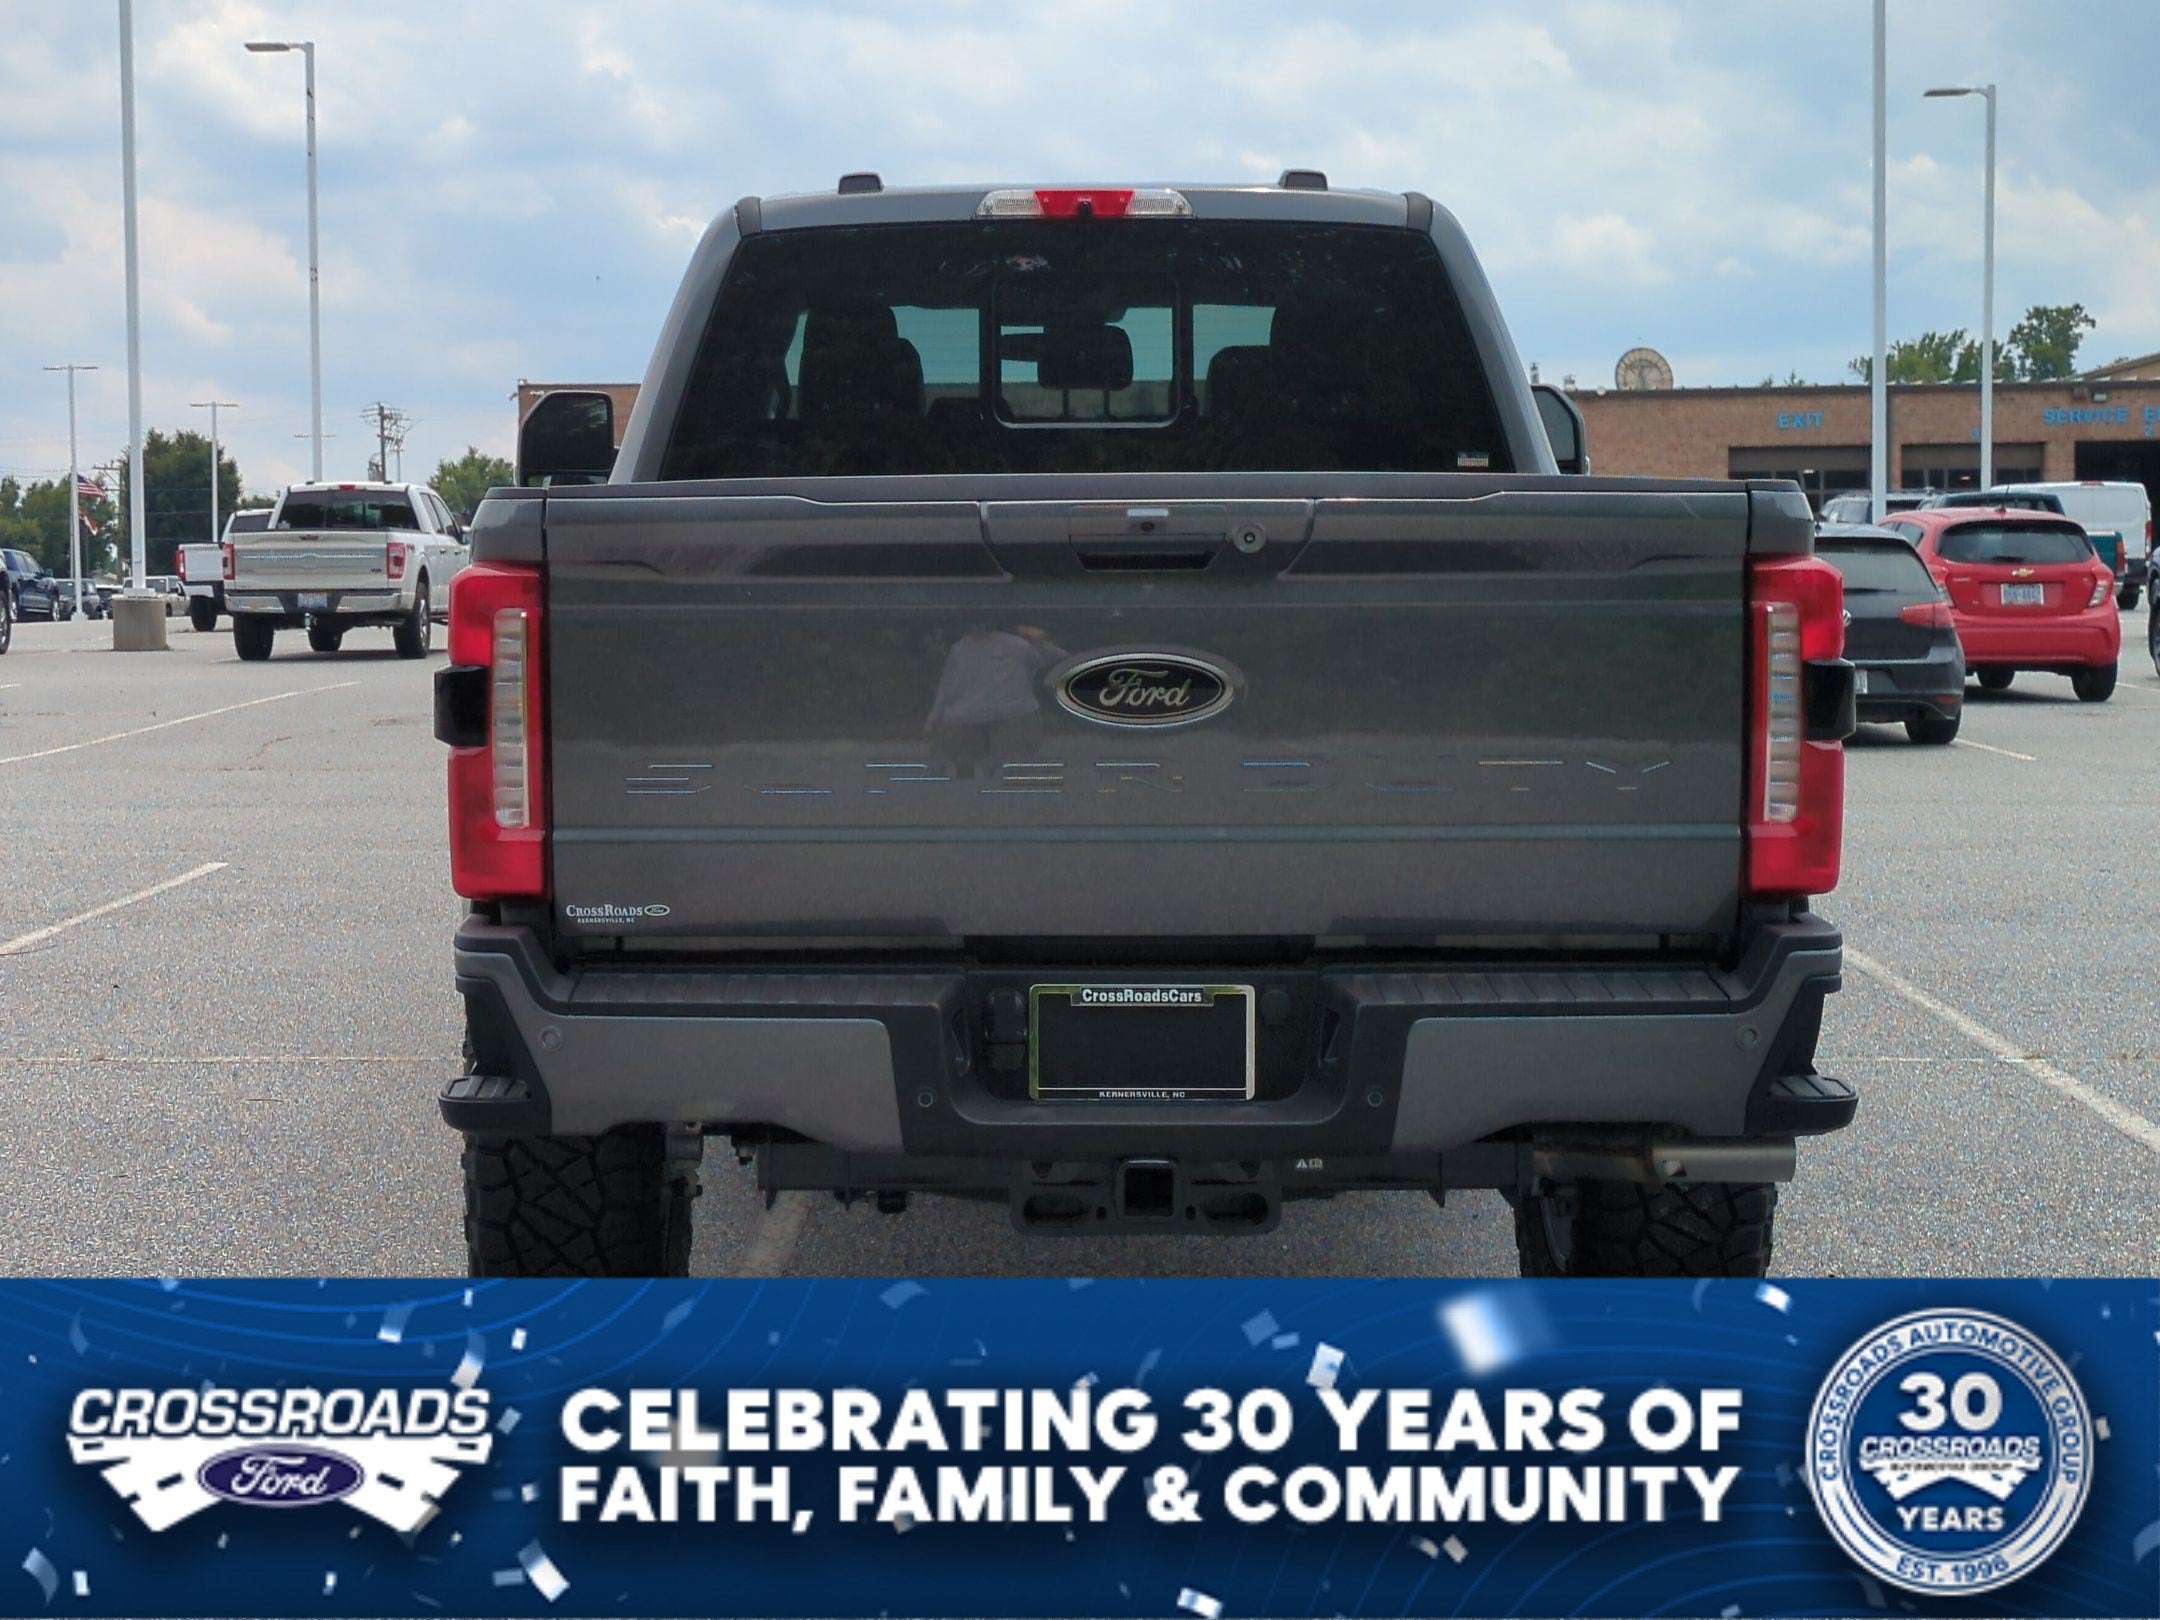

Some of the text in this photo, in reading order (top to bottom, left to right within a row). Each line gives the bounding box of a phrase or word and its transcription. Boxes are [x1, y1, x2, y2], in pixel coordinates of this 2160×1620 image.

[1777, 411, 1824, 429] EXIT
[2043, 406, 2129, 425] SERVICE
[1099, 667, 1193, 707] Ford
[1082, 988, 1202, 1003] CrossRoadsCars
[1099, 1091, 1170, 1099] KERNERSVILLE,
